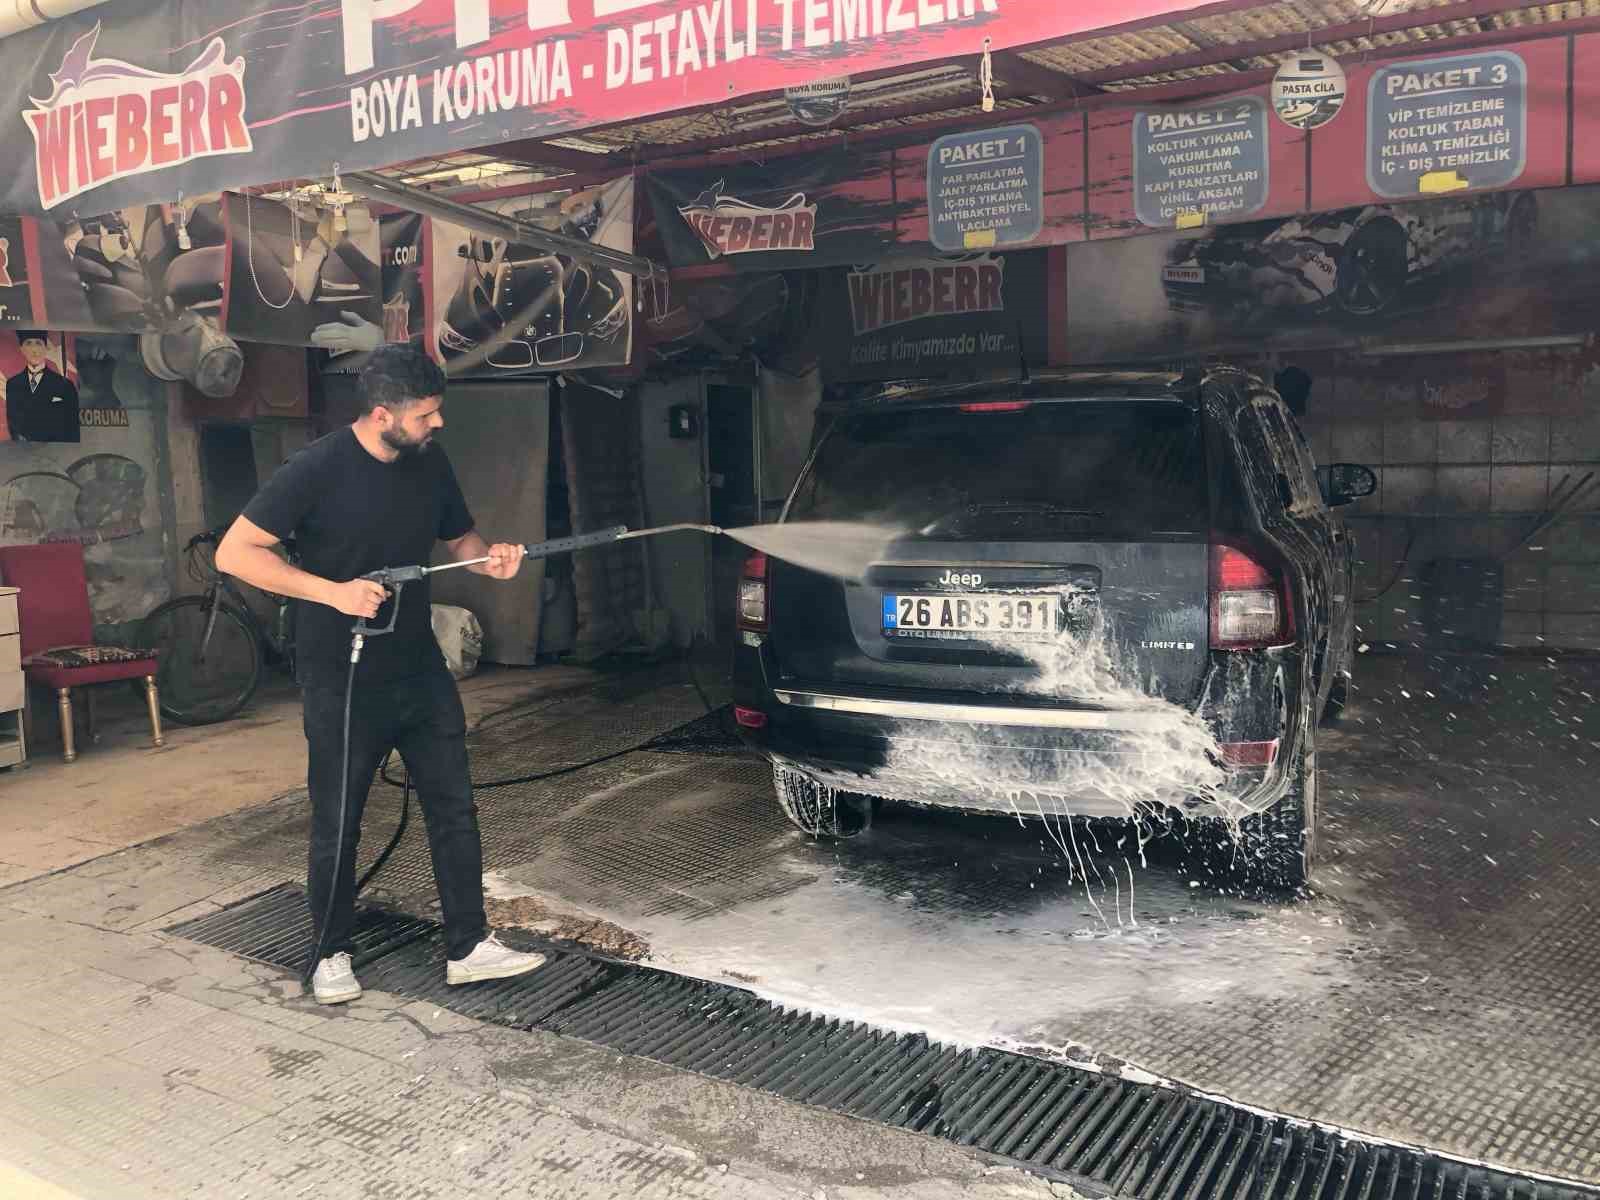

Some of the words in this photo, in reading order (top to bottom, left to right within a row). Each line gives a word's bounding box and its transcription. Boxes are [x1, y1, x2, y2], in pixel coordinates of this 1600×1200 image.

[350, 73, 424, 143] BOYA
[432, 40, 573, 125] KORUMA
[605, 0, 757, 90] DETAYLI
[1386, 66, 1482, 95] PAKET
[1491, 63, 1508, 84] 3
[1282, 84, 1312, 95] PASTA
[1313, 81, 1336, 93] CİLA
[1147, 110, 1225, 133] PAKET
[1235, 104, 1252, 120] 2
[1387, 107, 1413, 124] VİP
[1417, 97, 1505, 120] TEMİZLEME
[1387, 123, 1448, 142] KOLTUK
[1454, 114, 1504, 132] TABAN
[939, 138, 1009, 164] PAKET
[1015, 136, 1026, 153] 1
[1147, 137, 1198, 154] KOLTUK
[1201, 129, 1254, 146] YIKAMA
[1381, 141, 1428, 158] KLİMA
[1432, 128, 1511, 152] TEMİZLİĞİ
[1160, 145, 1241, 166] VAKUMLAMA
[1380, 160, 1396, 176] İÇ
[1408, 157, 1433, 172] DIŞ
[1438, 147, 1511, 168] TEMİZLİK
[966, 166, 1025, 181] PARLATMA
[1168, 160, 1233, 177] KURUTMA
[937, 185, 966, 197] JANT
[969, 177, 1029, 193] PARLATMA
[979, 191, 1023, 205] YIKAMA
[1144, 182, 1175, 193] KAPI
[1160, 191, 1194, 206] VİNİL
[1198, 186, 1243, 201] AKSAM
[939, 569, 982, 587] Jeep
[885, 613, 897, 624] TR
[899, 597, 932, 628] 26
[940, 598, 990, 629] ABS
[998, 599, 1049, 631] 391
[1141, 640, 1195, 651] LIMITED
